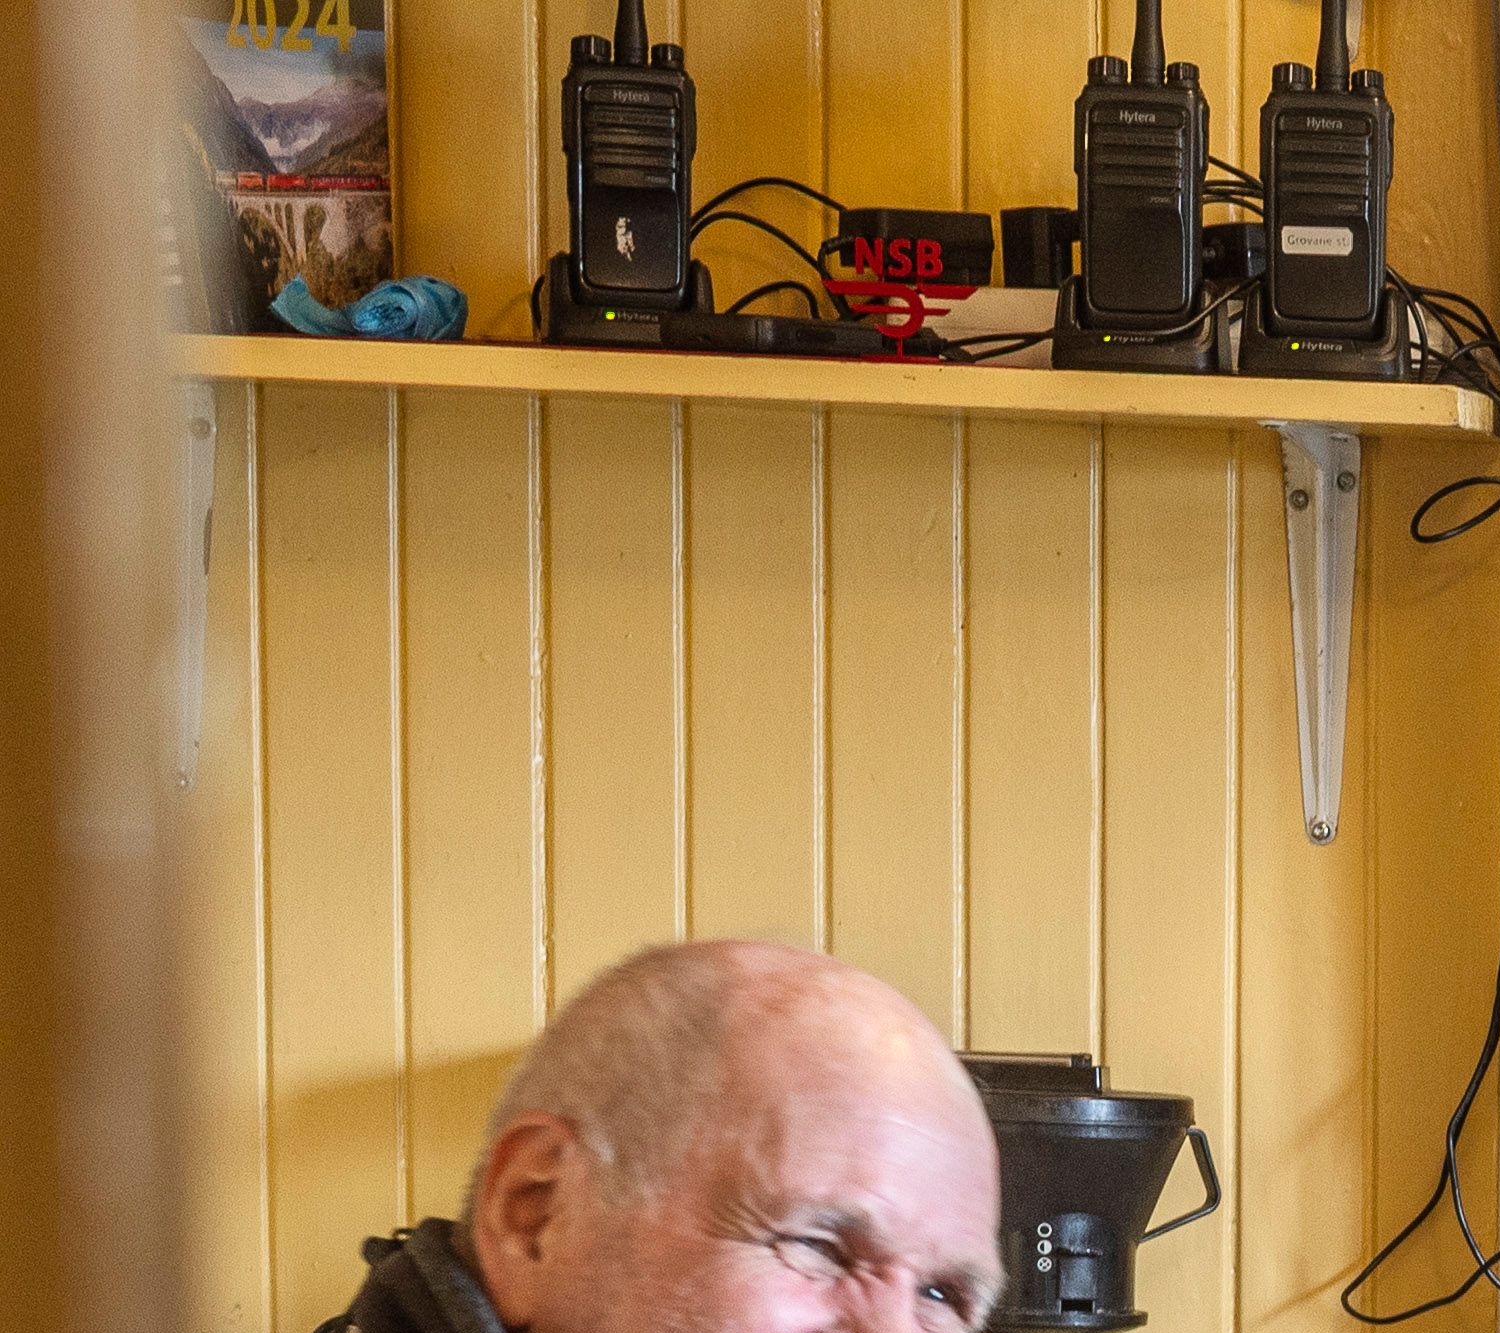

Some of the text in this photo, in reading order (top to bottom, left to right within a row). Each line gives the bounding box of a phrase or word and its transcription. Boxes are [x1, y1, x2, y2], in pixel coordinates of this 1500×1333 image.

[612, 89, 650, 102] Hytera
[1119, 109, 1156, 124] Hytera
[1306, 116, 1343, 131] Hytera
[854, 236, 944, 278] NSB
[1301, 341, 1343, 352] Hytera
